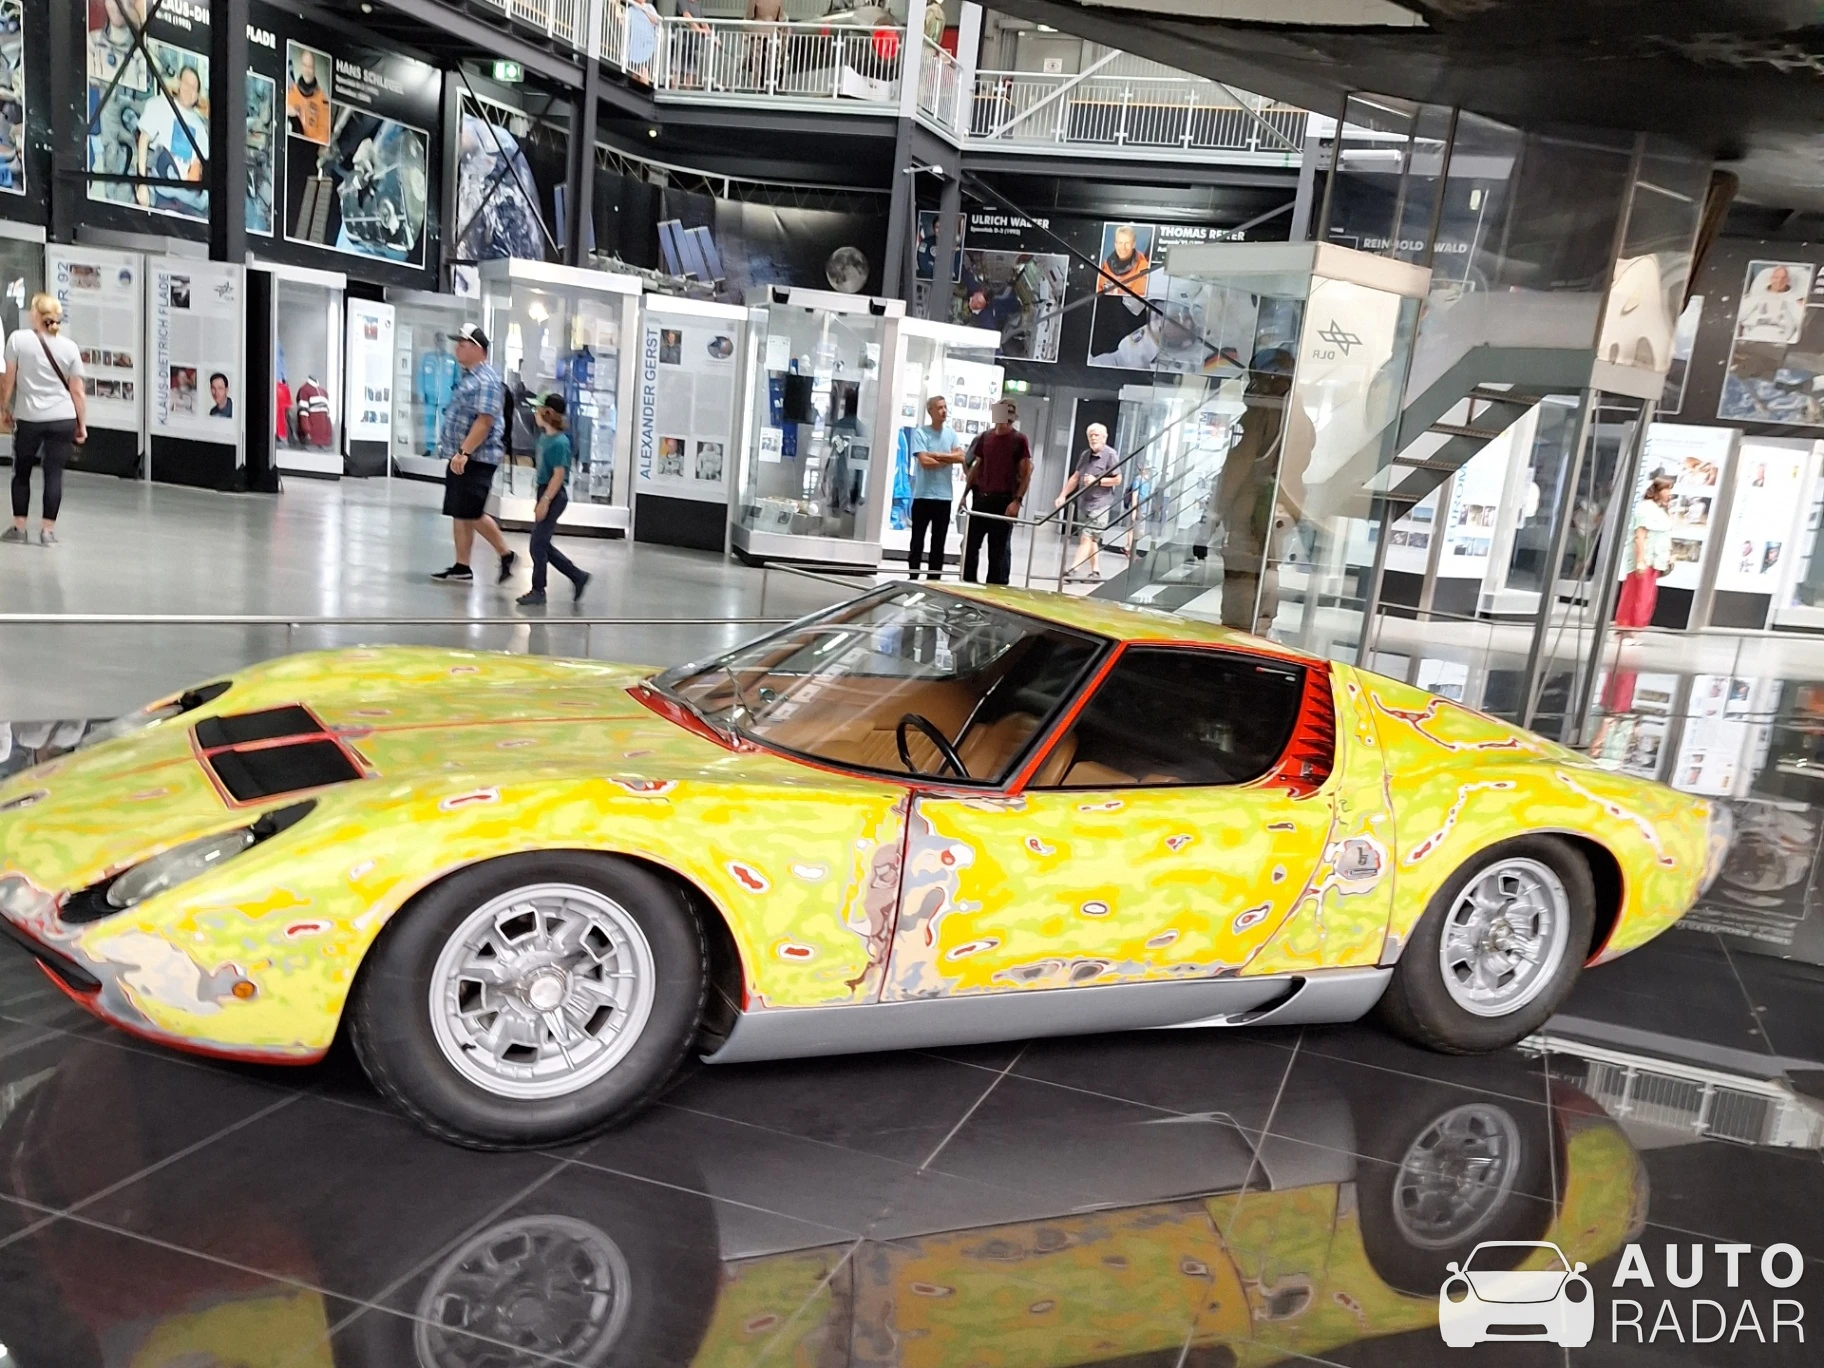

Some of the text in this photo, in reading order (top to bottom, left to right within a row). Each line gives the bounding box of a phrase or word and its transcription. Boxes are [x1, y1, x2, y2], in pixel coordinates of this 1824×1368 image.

[336, 58, 362, 80] HANS
[971, 214, 1008, 227] ULRICH
[1160, 226, 1207, 239] THOMAS
[1434, 242, 1468, 253] WALD
[57, 262, 69, 283] 92
[158, 273, 169, 426] KLAUS-DIETRICH FLADE
[640, 328, 659, 480] ALEXANDER GERST
[1447, 465, 1468, 542] EUROM
